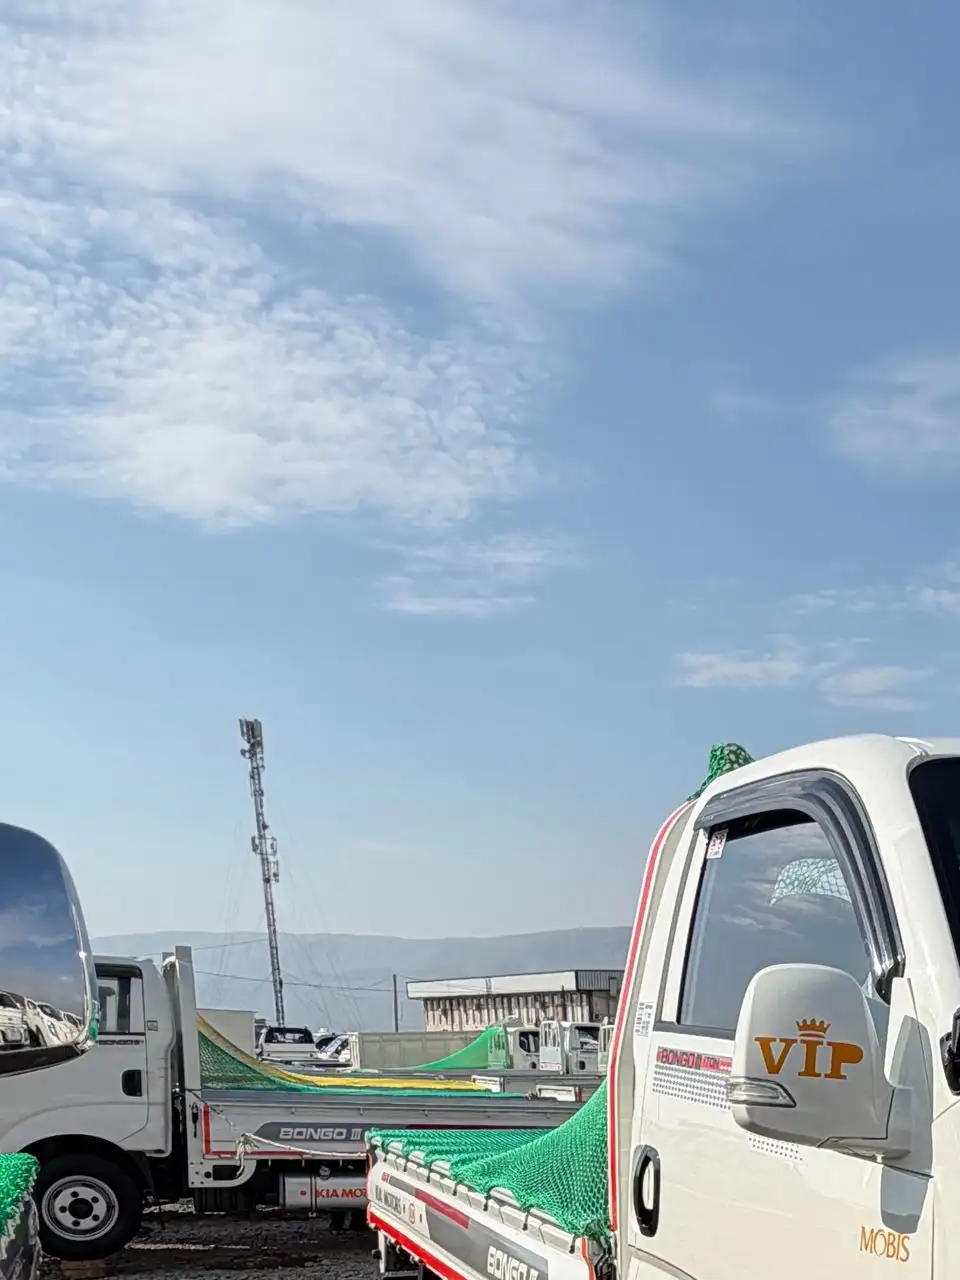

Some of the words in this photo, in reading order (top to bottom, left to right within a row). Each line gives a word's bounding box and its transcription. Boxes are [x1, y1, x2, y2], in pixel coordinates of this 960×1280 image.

[753, 1036, 865, 1080] VIP
[279, 1127, 348, 1140] BONGO
[315, 1188, 340, 1199] KIA
[859, 1226, 911, 1262] MOBIS
